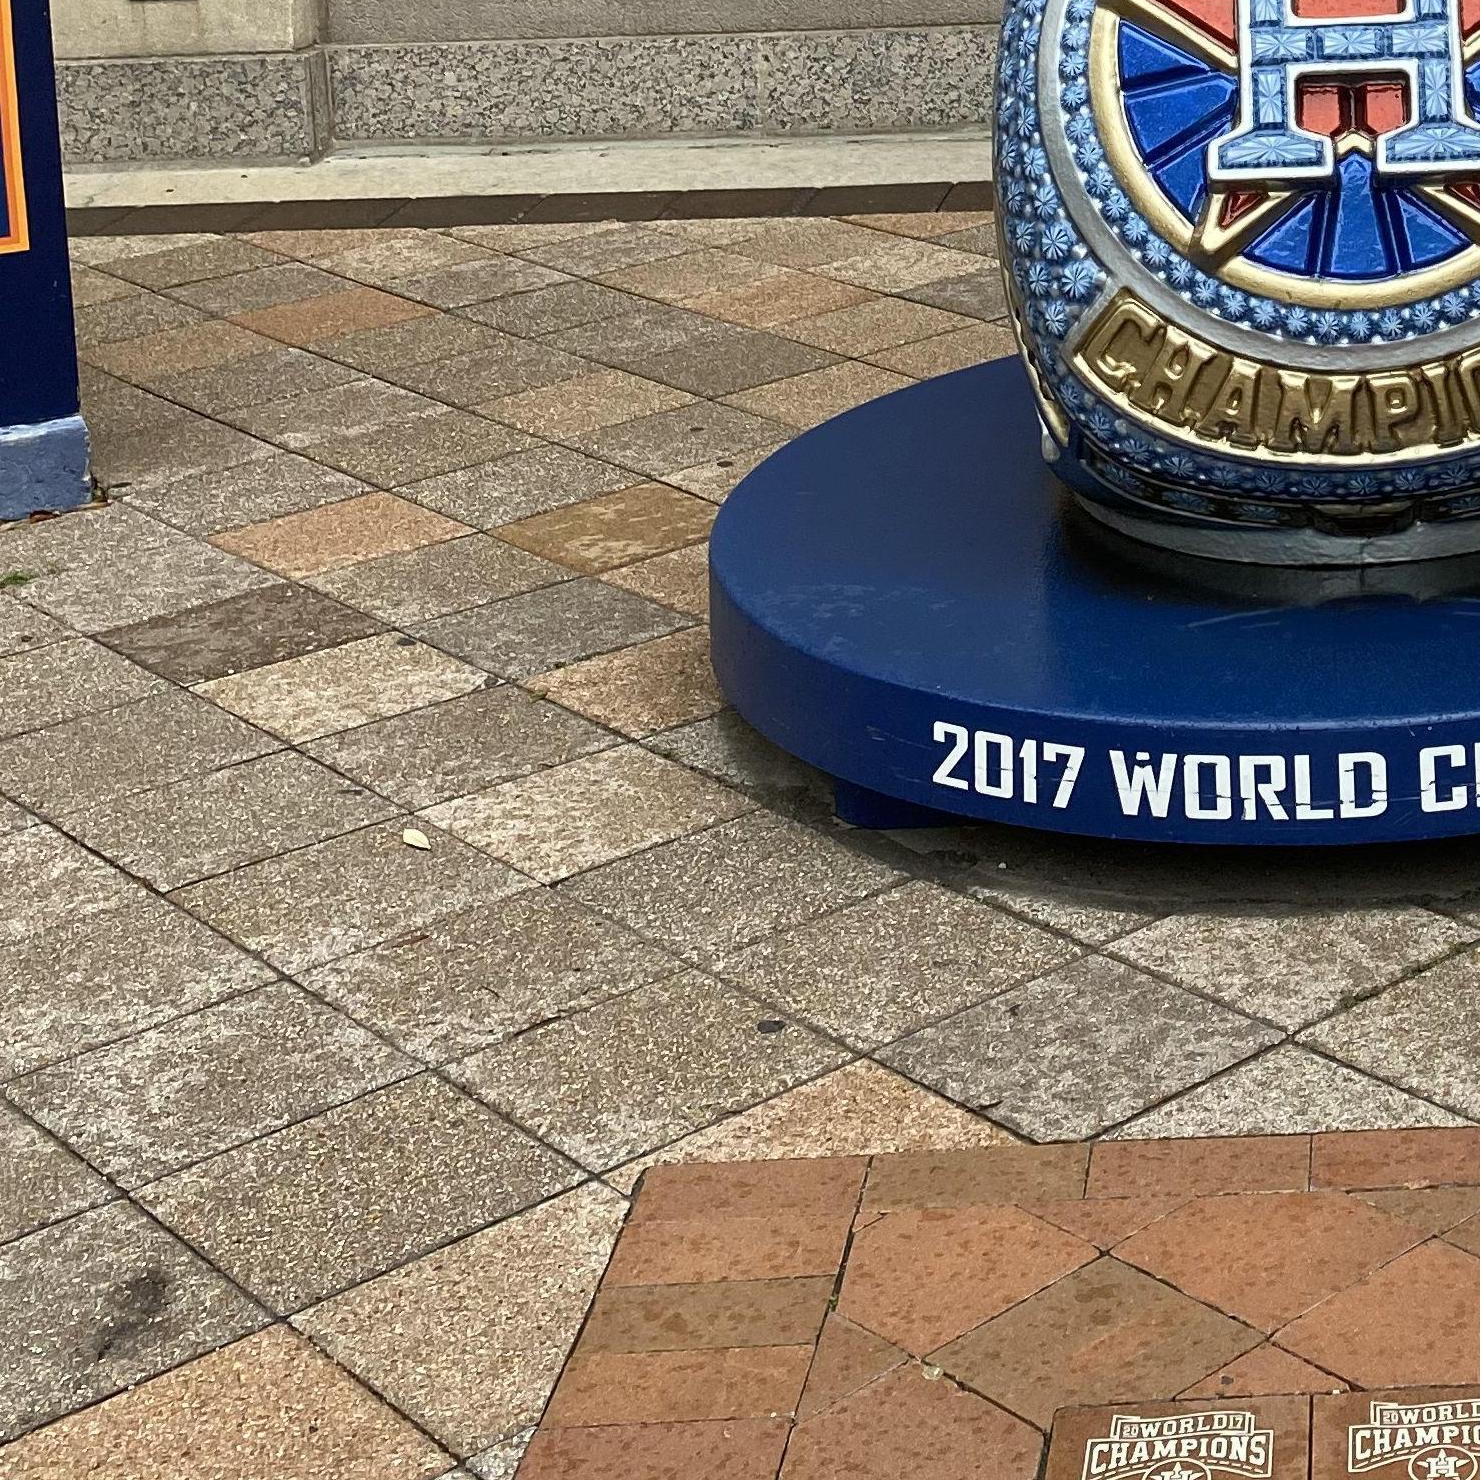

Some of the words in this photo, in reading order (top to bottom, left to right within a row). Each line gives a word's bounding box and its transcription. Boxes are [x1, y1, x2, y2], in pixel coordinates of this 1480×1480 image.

[931, 720, 1086, 809] 2017
[1109, 746, 1389, 821] WORLD
[1139, 1414, 1228, 1438] WORLD
[1091, 1435, 1266, 1475] CHAMPIONS
